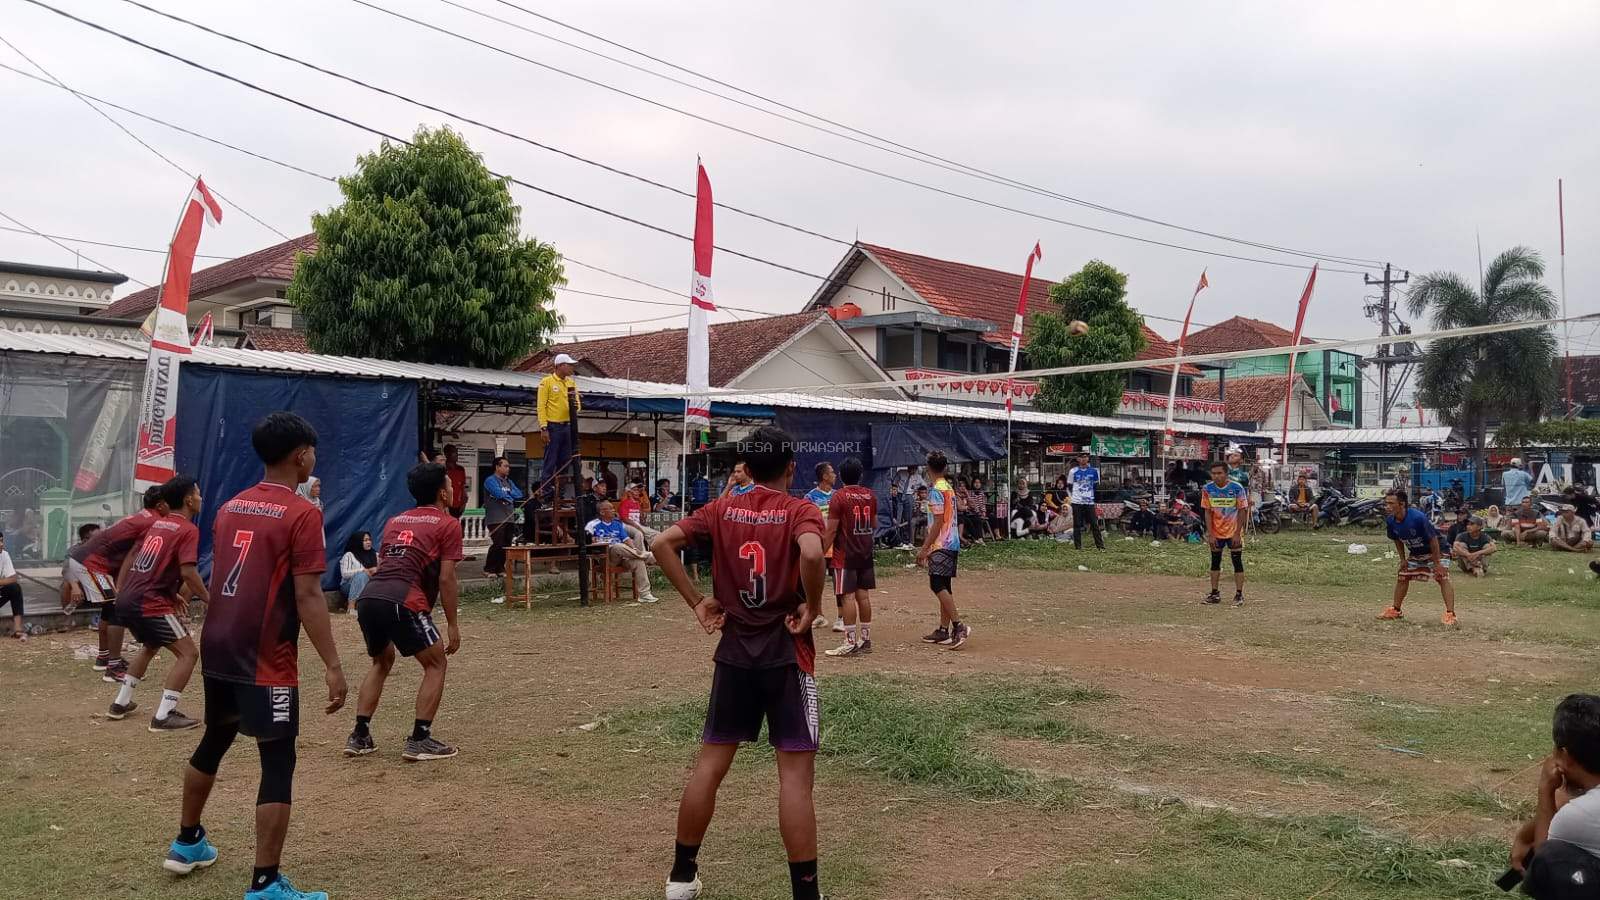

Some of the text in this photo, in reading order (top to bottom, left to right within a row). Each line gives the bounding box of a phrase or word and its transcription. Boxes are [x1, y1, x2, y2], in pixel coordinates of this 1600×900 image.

[852, 505, 873, 535] 11
[129, 535, 163, 573] 10
[221, 529, 254, 597] 7
[739, 540, 767, 609] 3
[272, 686, 290, 723] MASH
